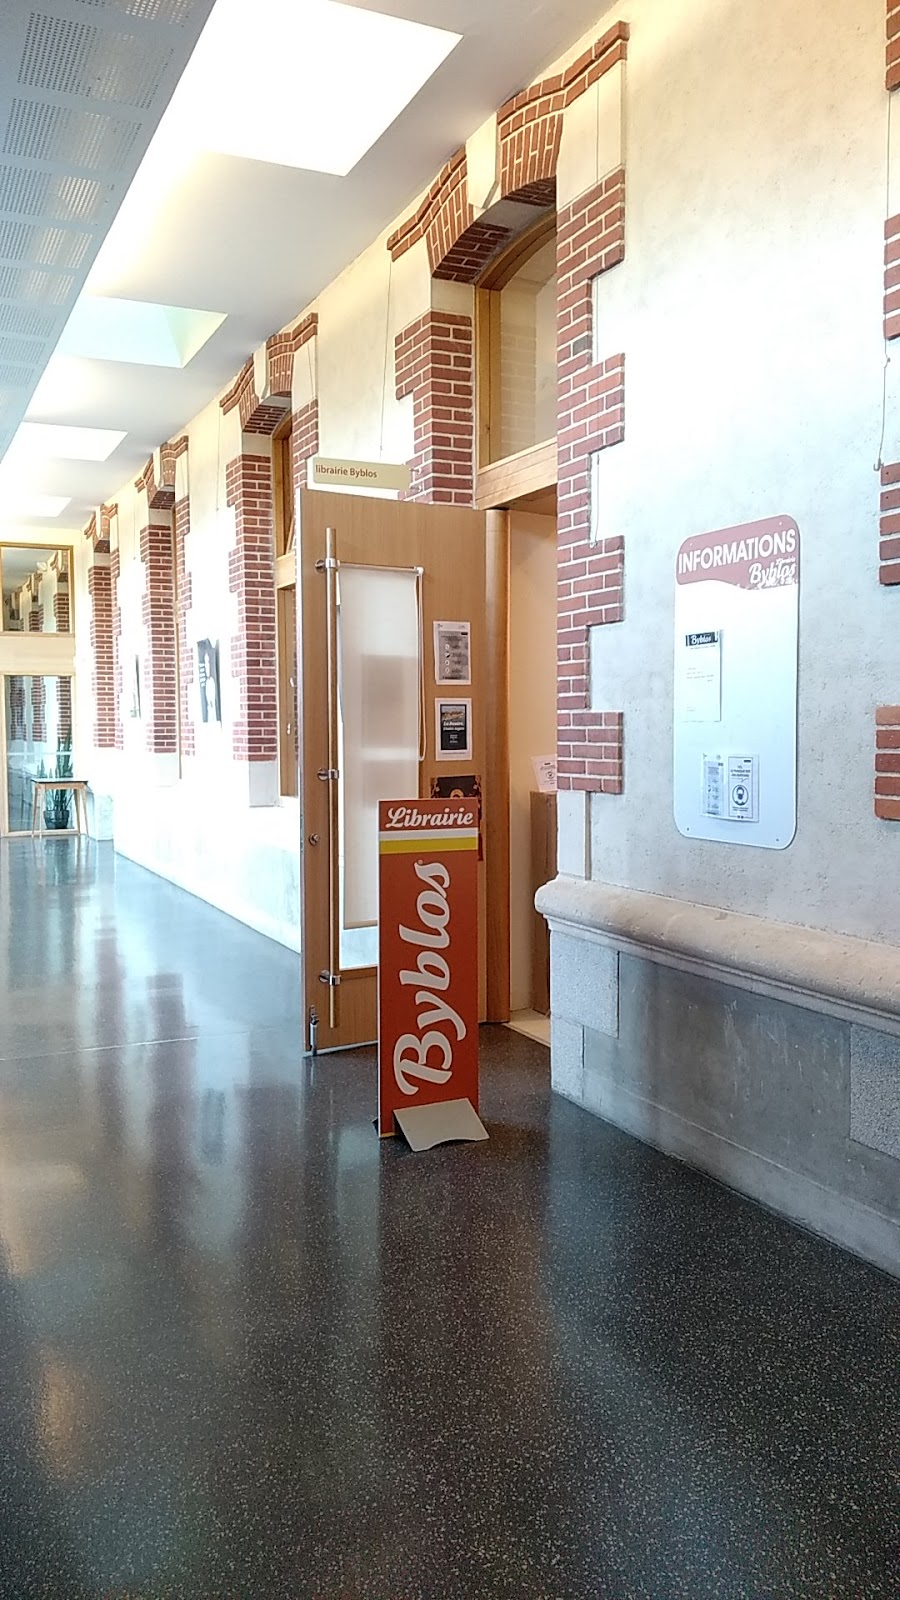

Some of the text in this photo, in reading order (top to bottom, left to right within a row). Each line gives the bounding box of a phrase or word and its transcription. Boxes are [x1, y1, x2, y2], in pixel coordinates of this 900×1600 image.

[315, 464, 378, 478] librairie Byblos
[678, 529, 796, 574] INFORMATIONS
[748, 561, 797, 588] Byblos
[385, 806, 474, 828] Librairie
[393, 860, 467, 1095] Byblos
